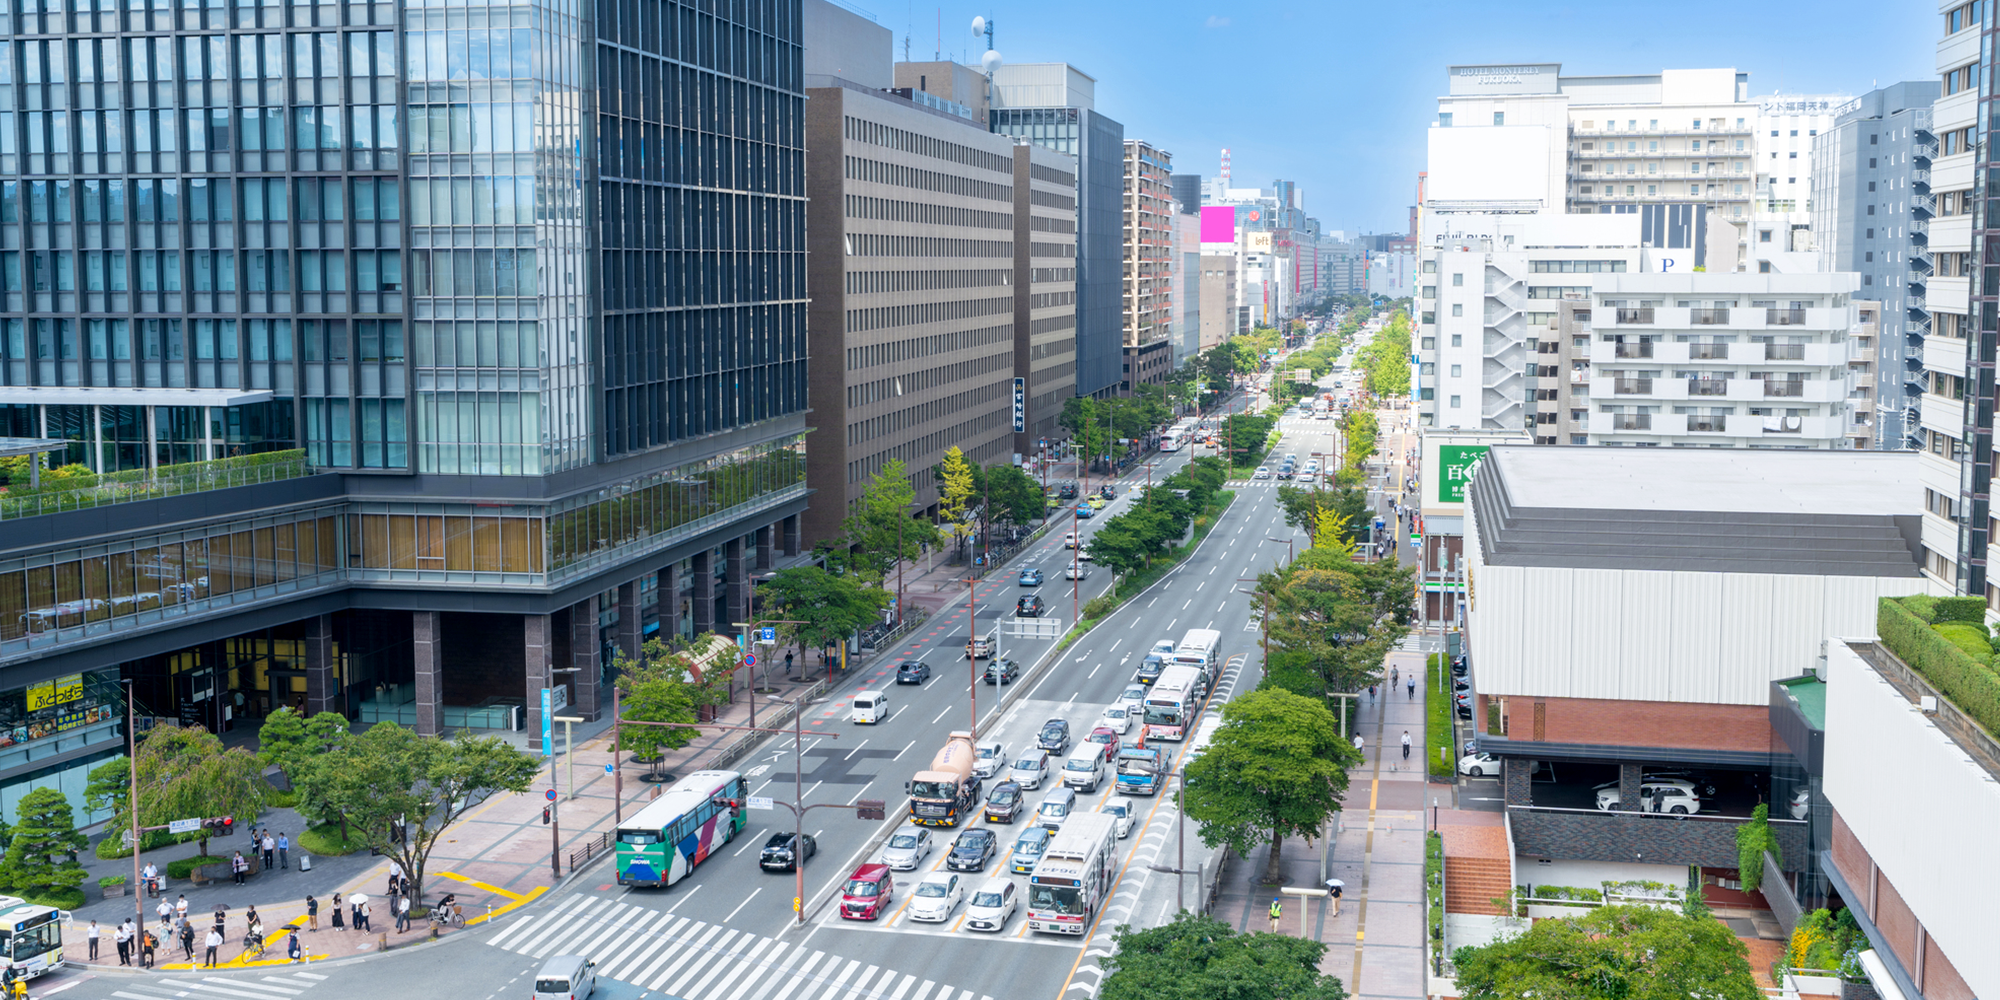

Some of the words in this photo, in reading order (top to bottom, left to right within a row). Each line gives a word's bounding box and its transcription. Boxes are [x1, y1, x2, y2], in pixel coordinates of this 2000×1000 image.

[1460, 68, 1489, 77] HOTEL
[1491, 66, 1540, 76] MONTEREY
[1478, 76, 1522, 85] FUKUOKA
[1660, 257, 1675, 273] P
